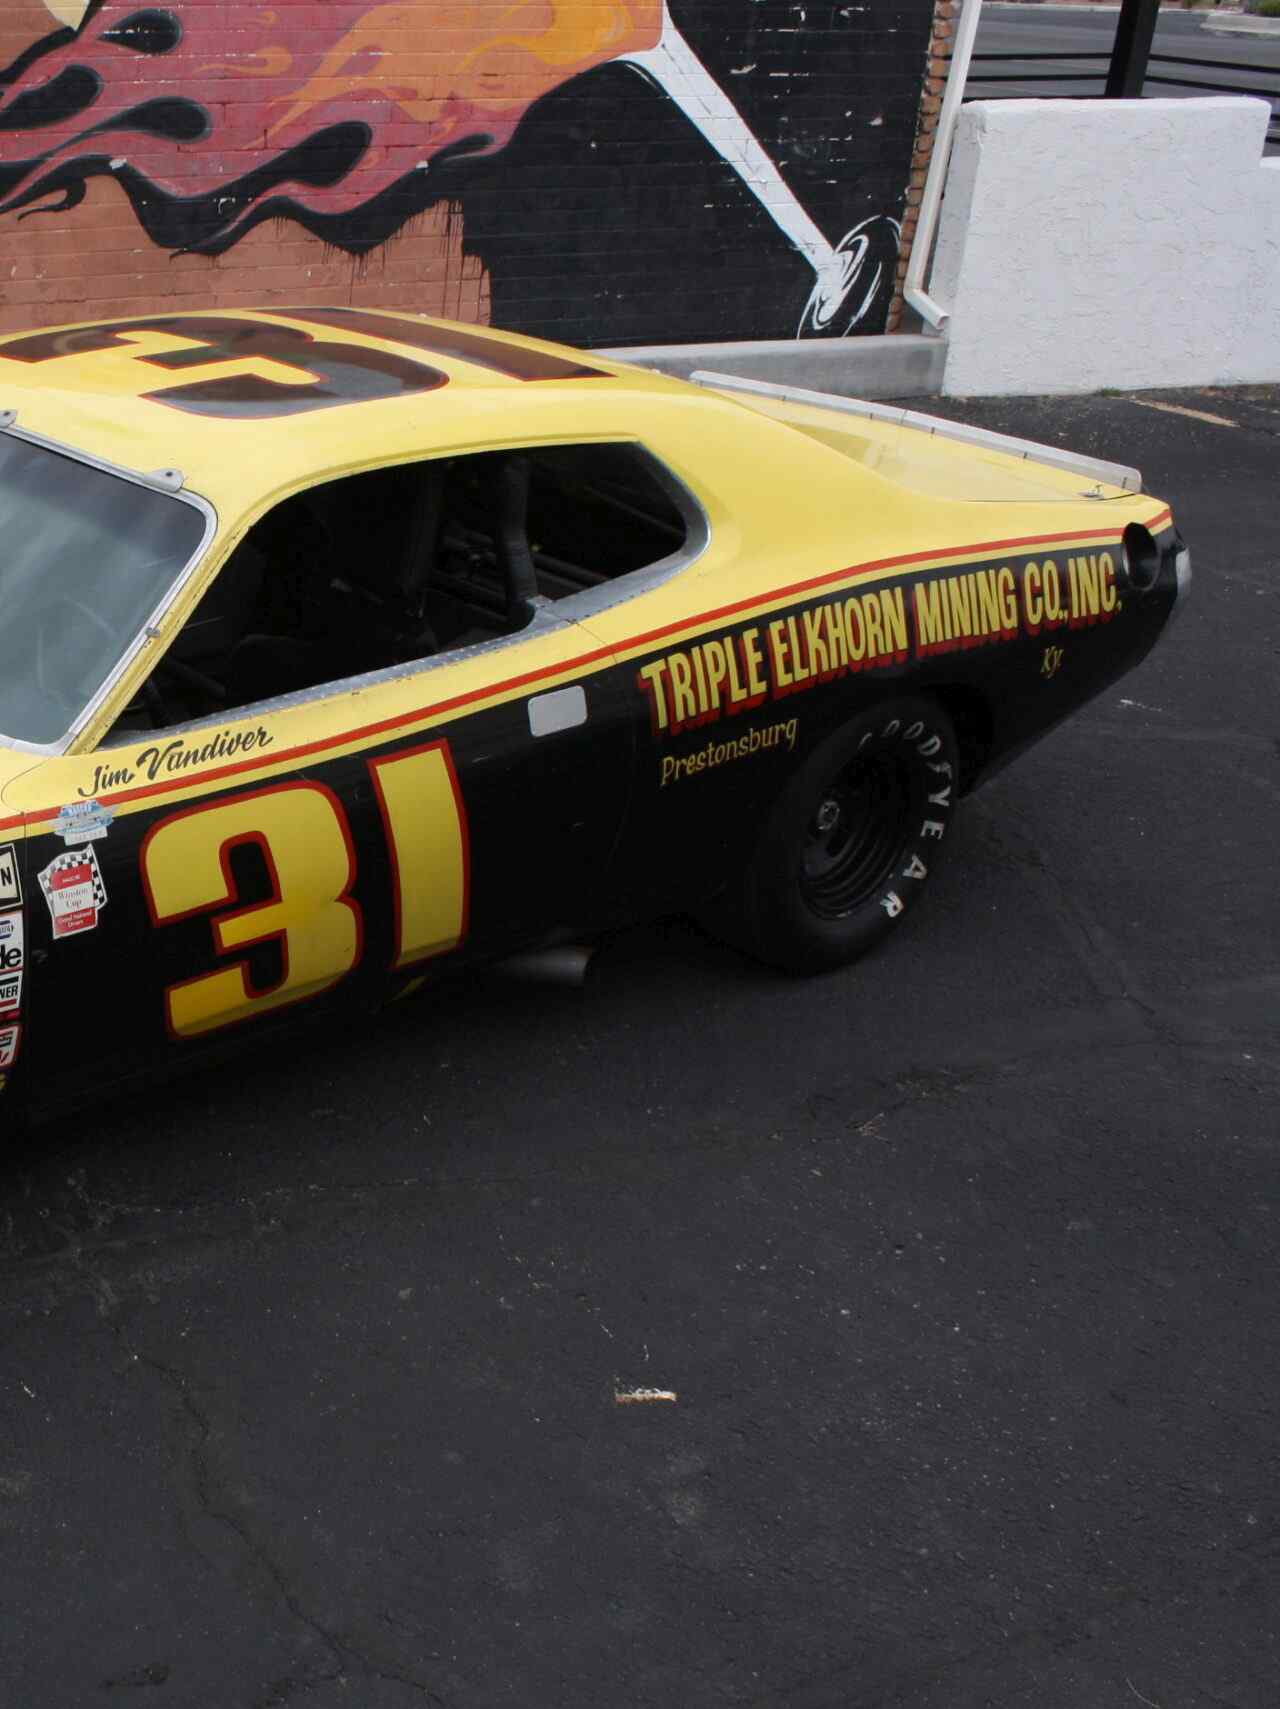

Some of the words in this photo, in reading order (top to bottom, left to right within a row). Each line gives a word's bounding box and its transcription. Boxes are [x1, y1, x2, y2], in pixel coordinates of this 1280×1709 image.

[638, 627, 767, 732] TRIPLE
[768, 587, 908, 690] ELKHORN
[914, 566, 1018, 649] MINING
[77, 764, 136, 798] Jim
[135, 725, 274, 781] Vandiver
[660, 717, 799, 787] Prestonsburg
[140, 737, 470, 1041] 31
